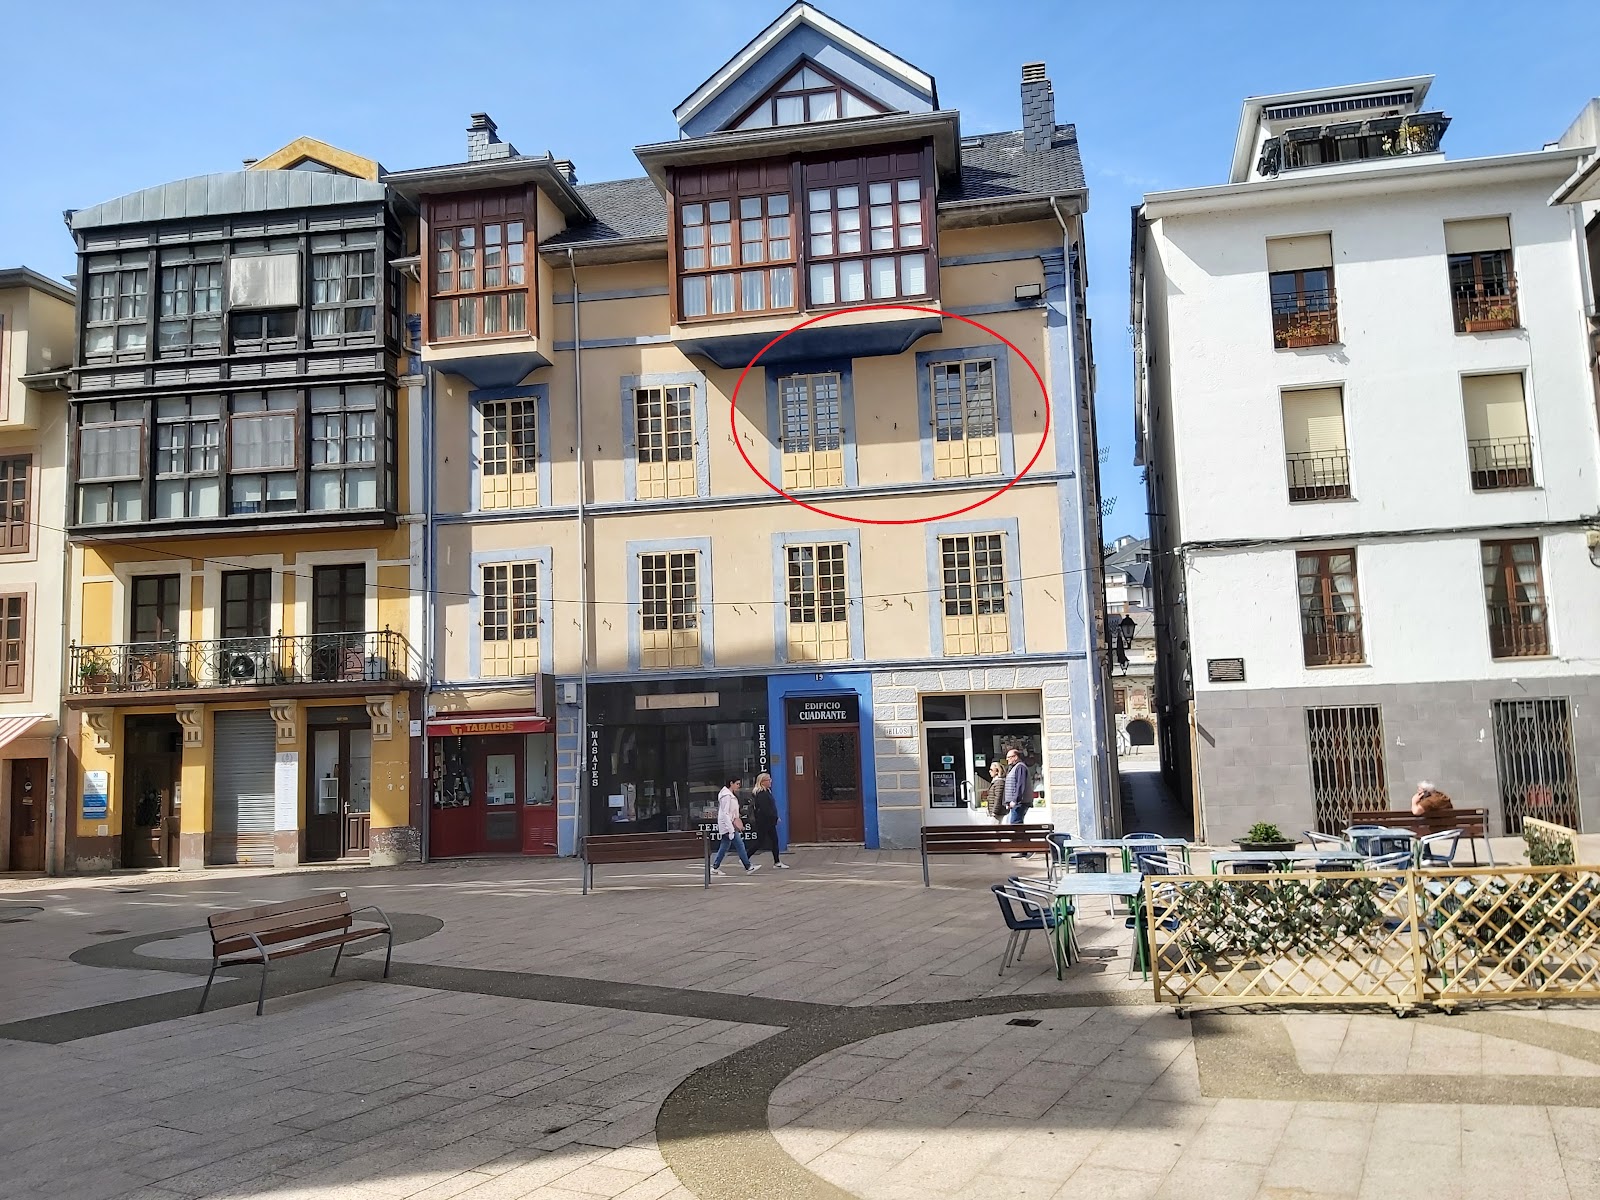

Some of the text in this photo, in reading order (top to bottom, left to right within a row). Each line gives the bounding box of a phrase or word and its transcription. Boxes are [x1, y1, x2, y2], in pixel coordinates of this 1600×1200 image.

[805, 702, 841, 710] EDIFICIO
[799, 711, 847, 721] CUADRANTE
[465, 722, 514, 732] TABACOS
[758, 724, 767, 773] HERBOL
[591, 731, 599, 787] MASAJES
[698, 823, 751, 832] TERS
